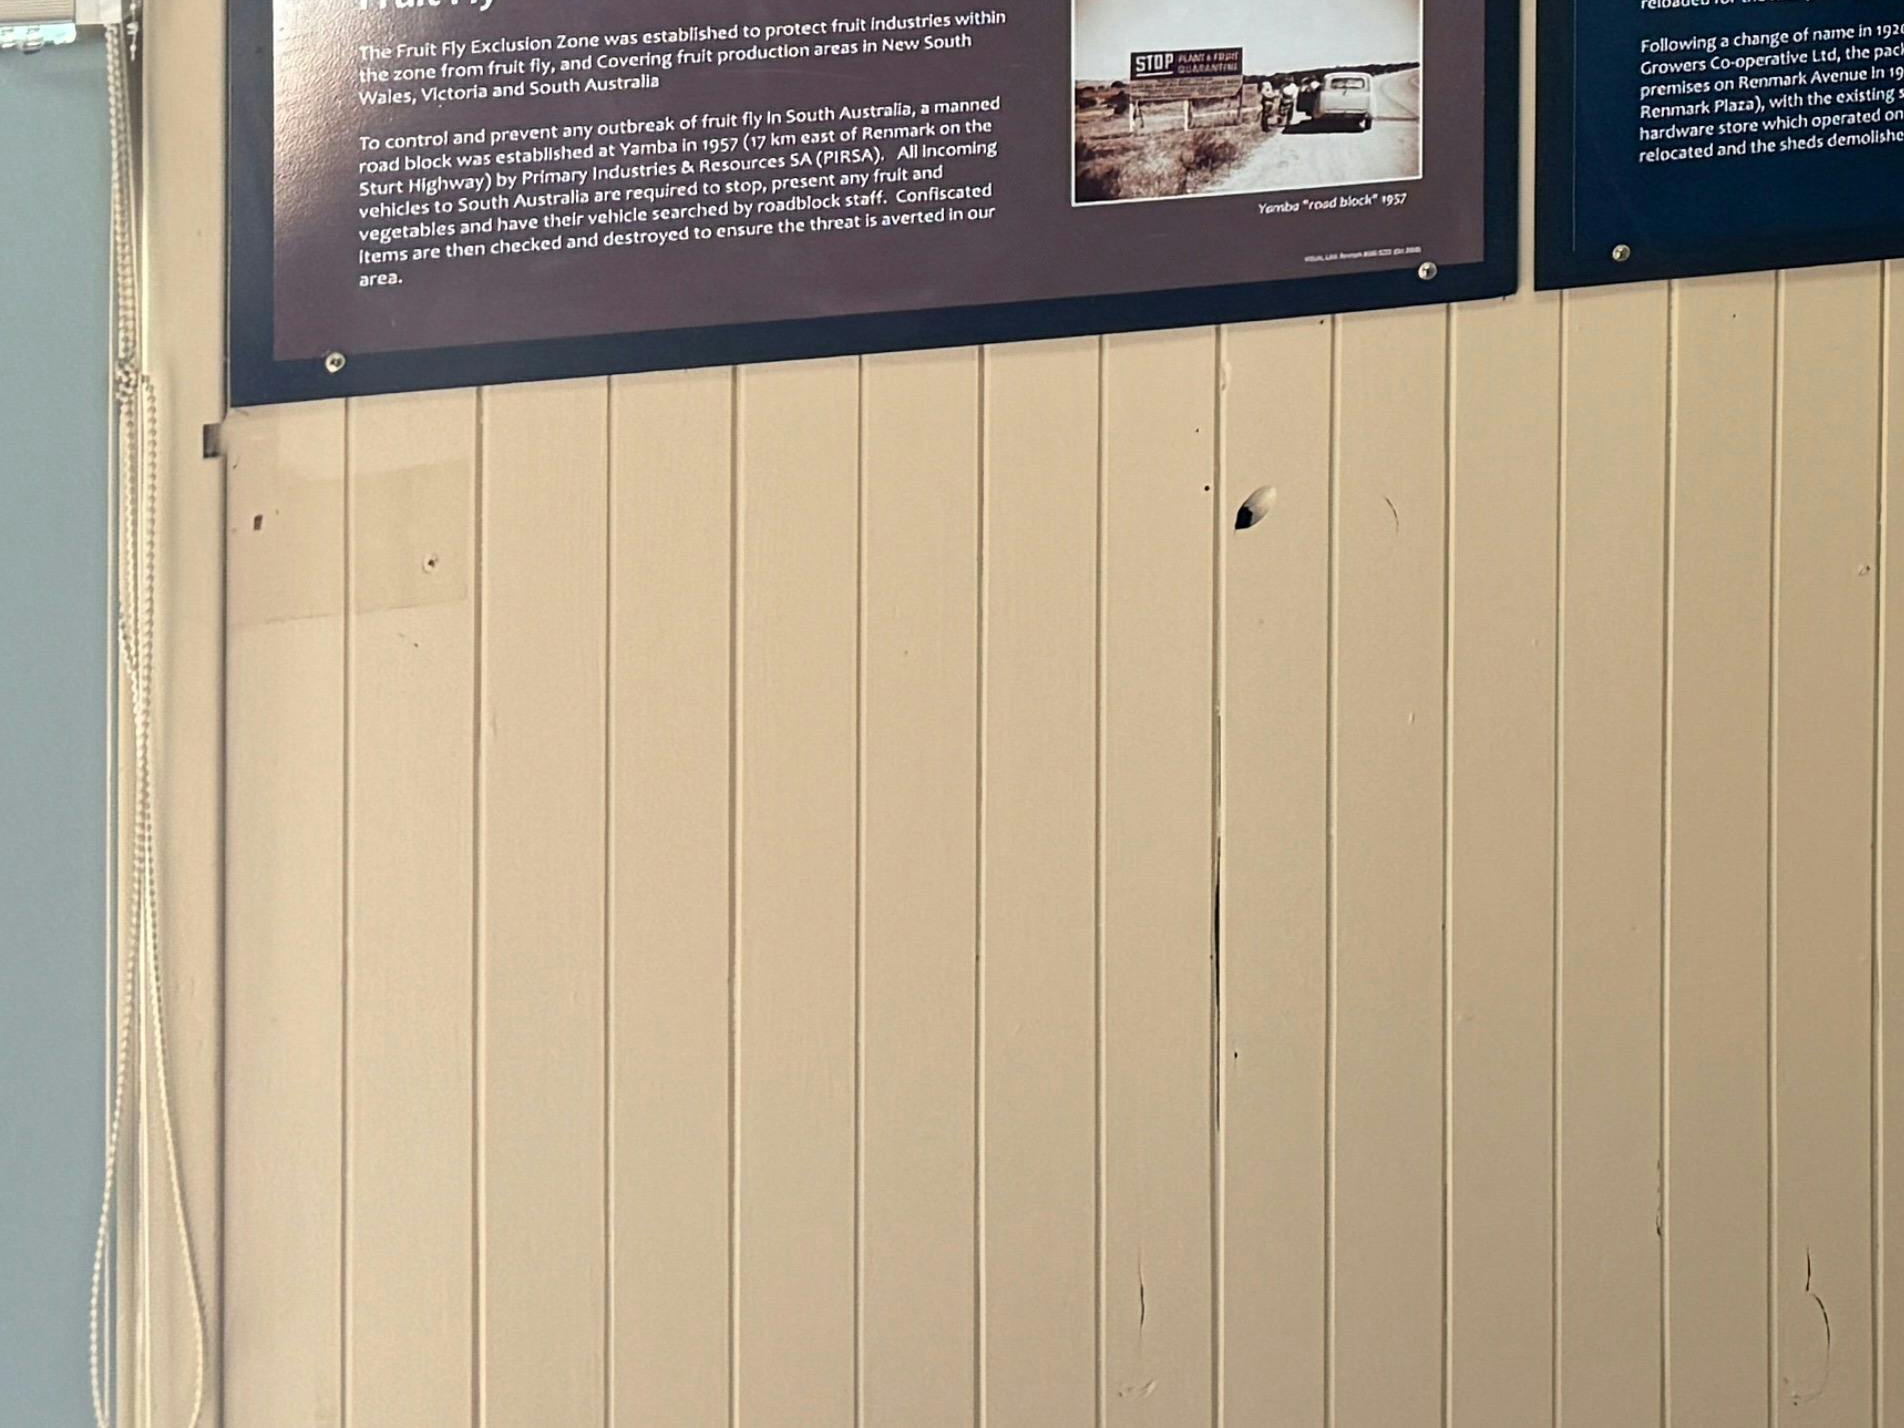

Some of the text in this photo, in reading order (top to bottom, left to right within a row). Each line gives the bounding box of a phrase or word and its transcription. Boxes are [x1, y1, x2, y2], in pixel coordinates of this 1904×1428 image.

[359, 73, 660, 107] Wales, Victoria and South Australia
[1639, 142, 1714, 163] relocated
[1716, 139, 1747, 156] and
[1750, 138, 1777, 154] the
[1779, 134, 1824, 152] sheds
[1258, 192, 1408, 214] Yamba "road block" 1957
